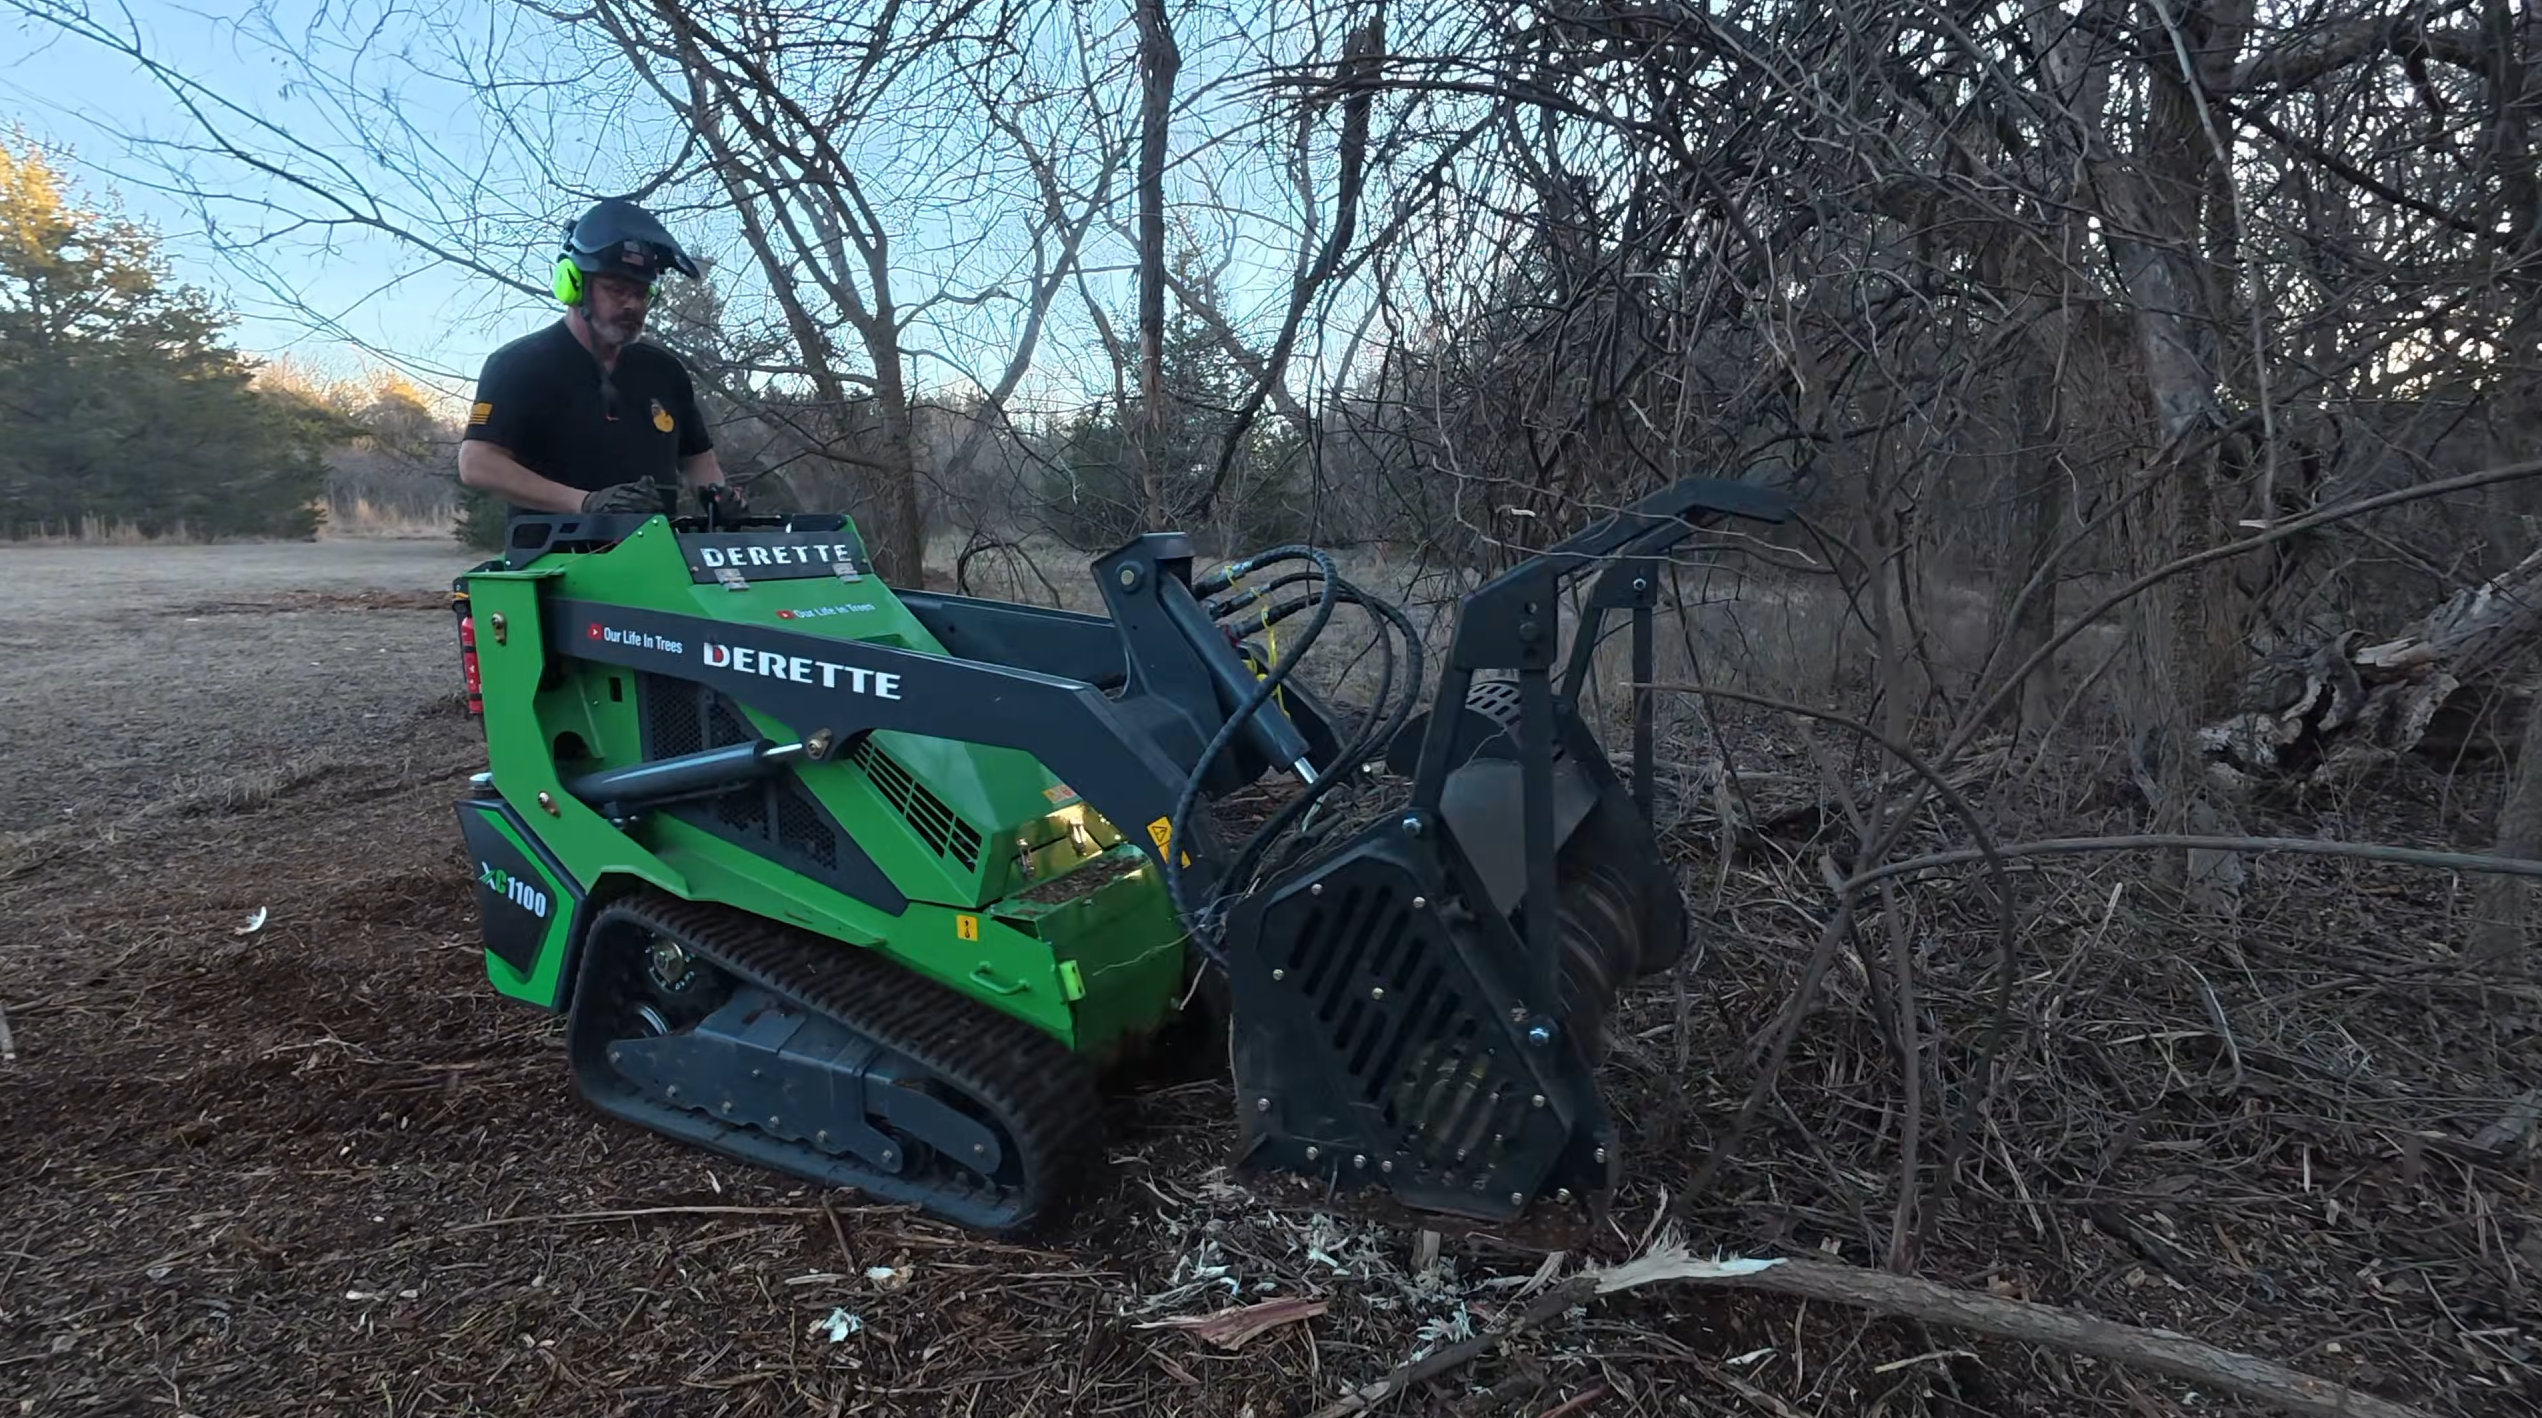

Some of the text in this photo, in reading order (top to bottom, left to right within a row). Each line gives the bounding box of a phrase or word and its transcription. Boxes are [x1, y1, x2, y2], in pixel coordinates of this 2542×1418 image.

[700, 544, 852, 567] DERETTE
[793, 609, 815, 618] Our
[815, 606, 836, 616] Life
[847, 603, 876, 612] Trees
[604, 627, 683, 654] Our Life In Trees
[703, 642, 902, 700] DERETTE
[478, 861, 547, 918] XC1100
